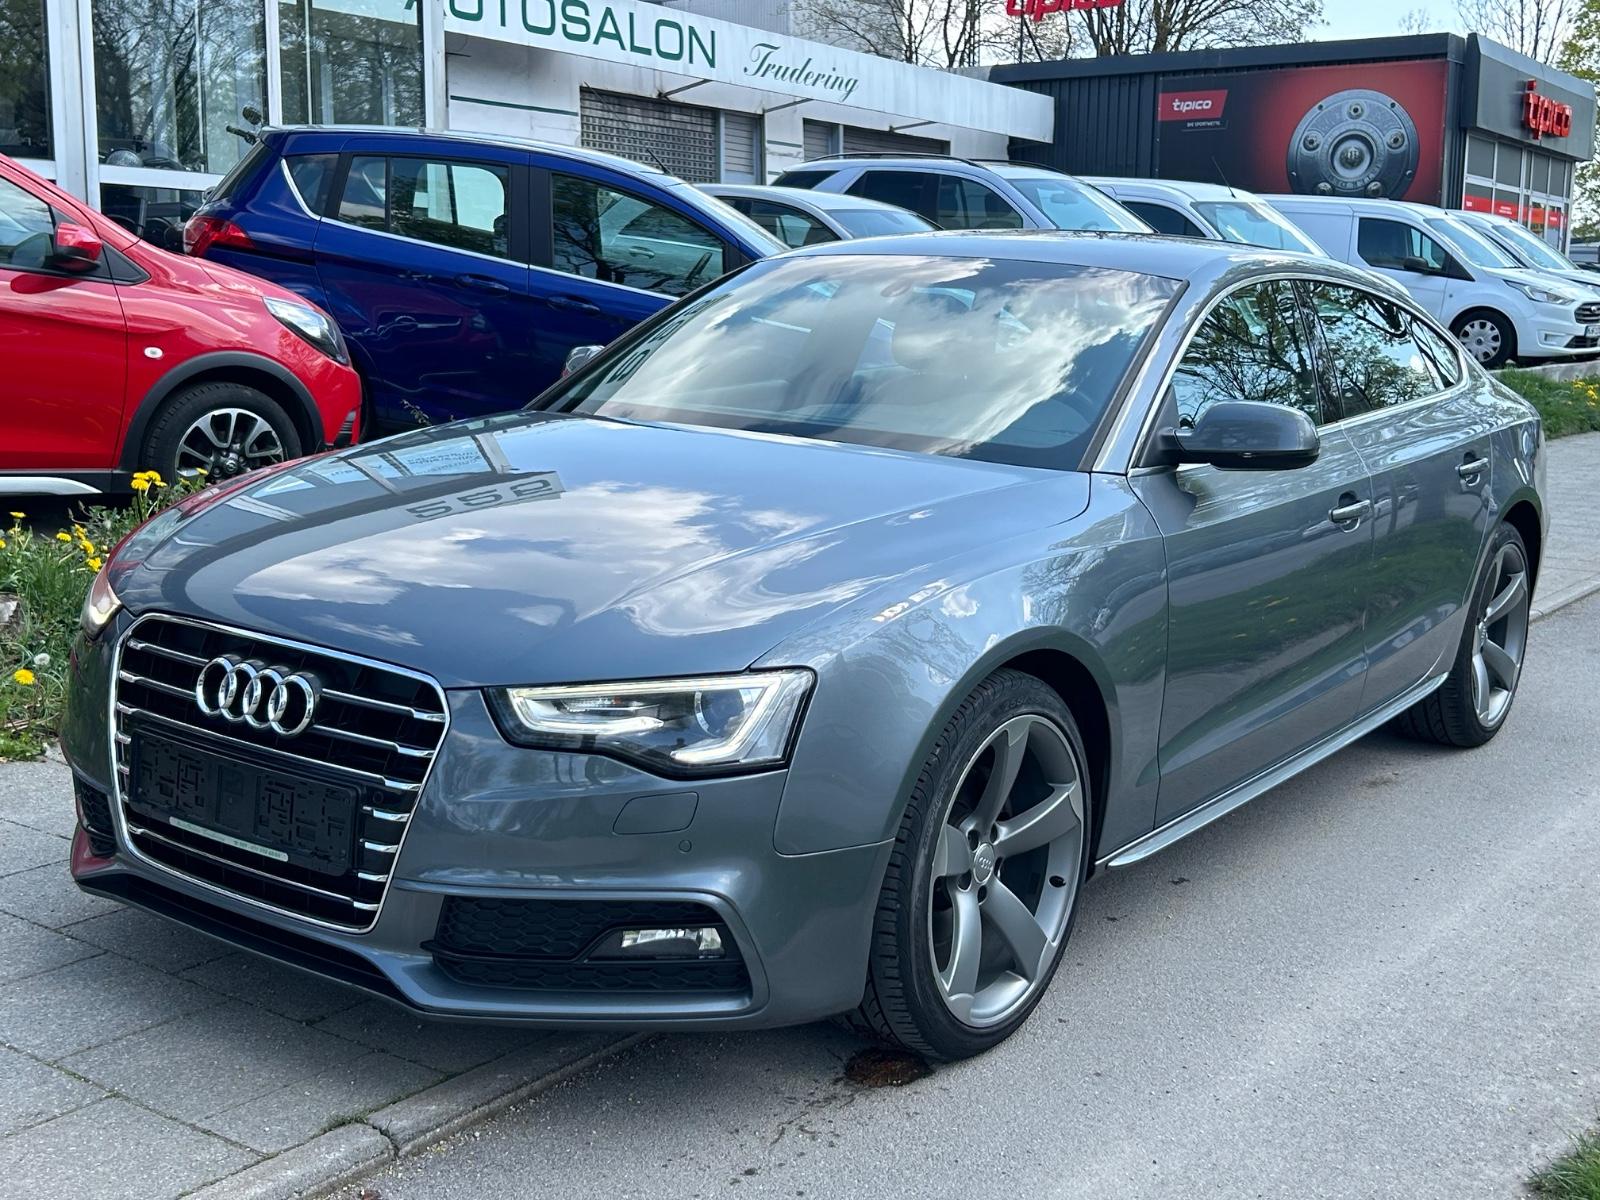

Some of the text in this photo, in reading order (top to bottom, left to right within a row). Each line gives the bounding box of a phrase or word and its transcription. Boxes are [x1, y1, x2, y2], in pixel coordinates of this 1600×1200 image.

[404, 0, 717, 68] OSALON
[744, 43, 859, 100] Trudering
[1172, 98, 1213, 113] tipico
